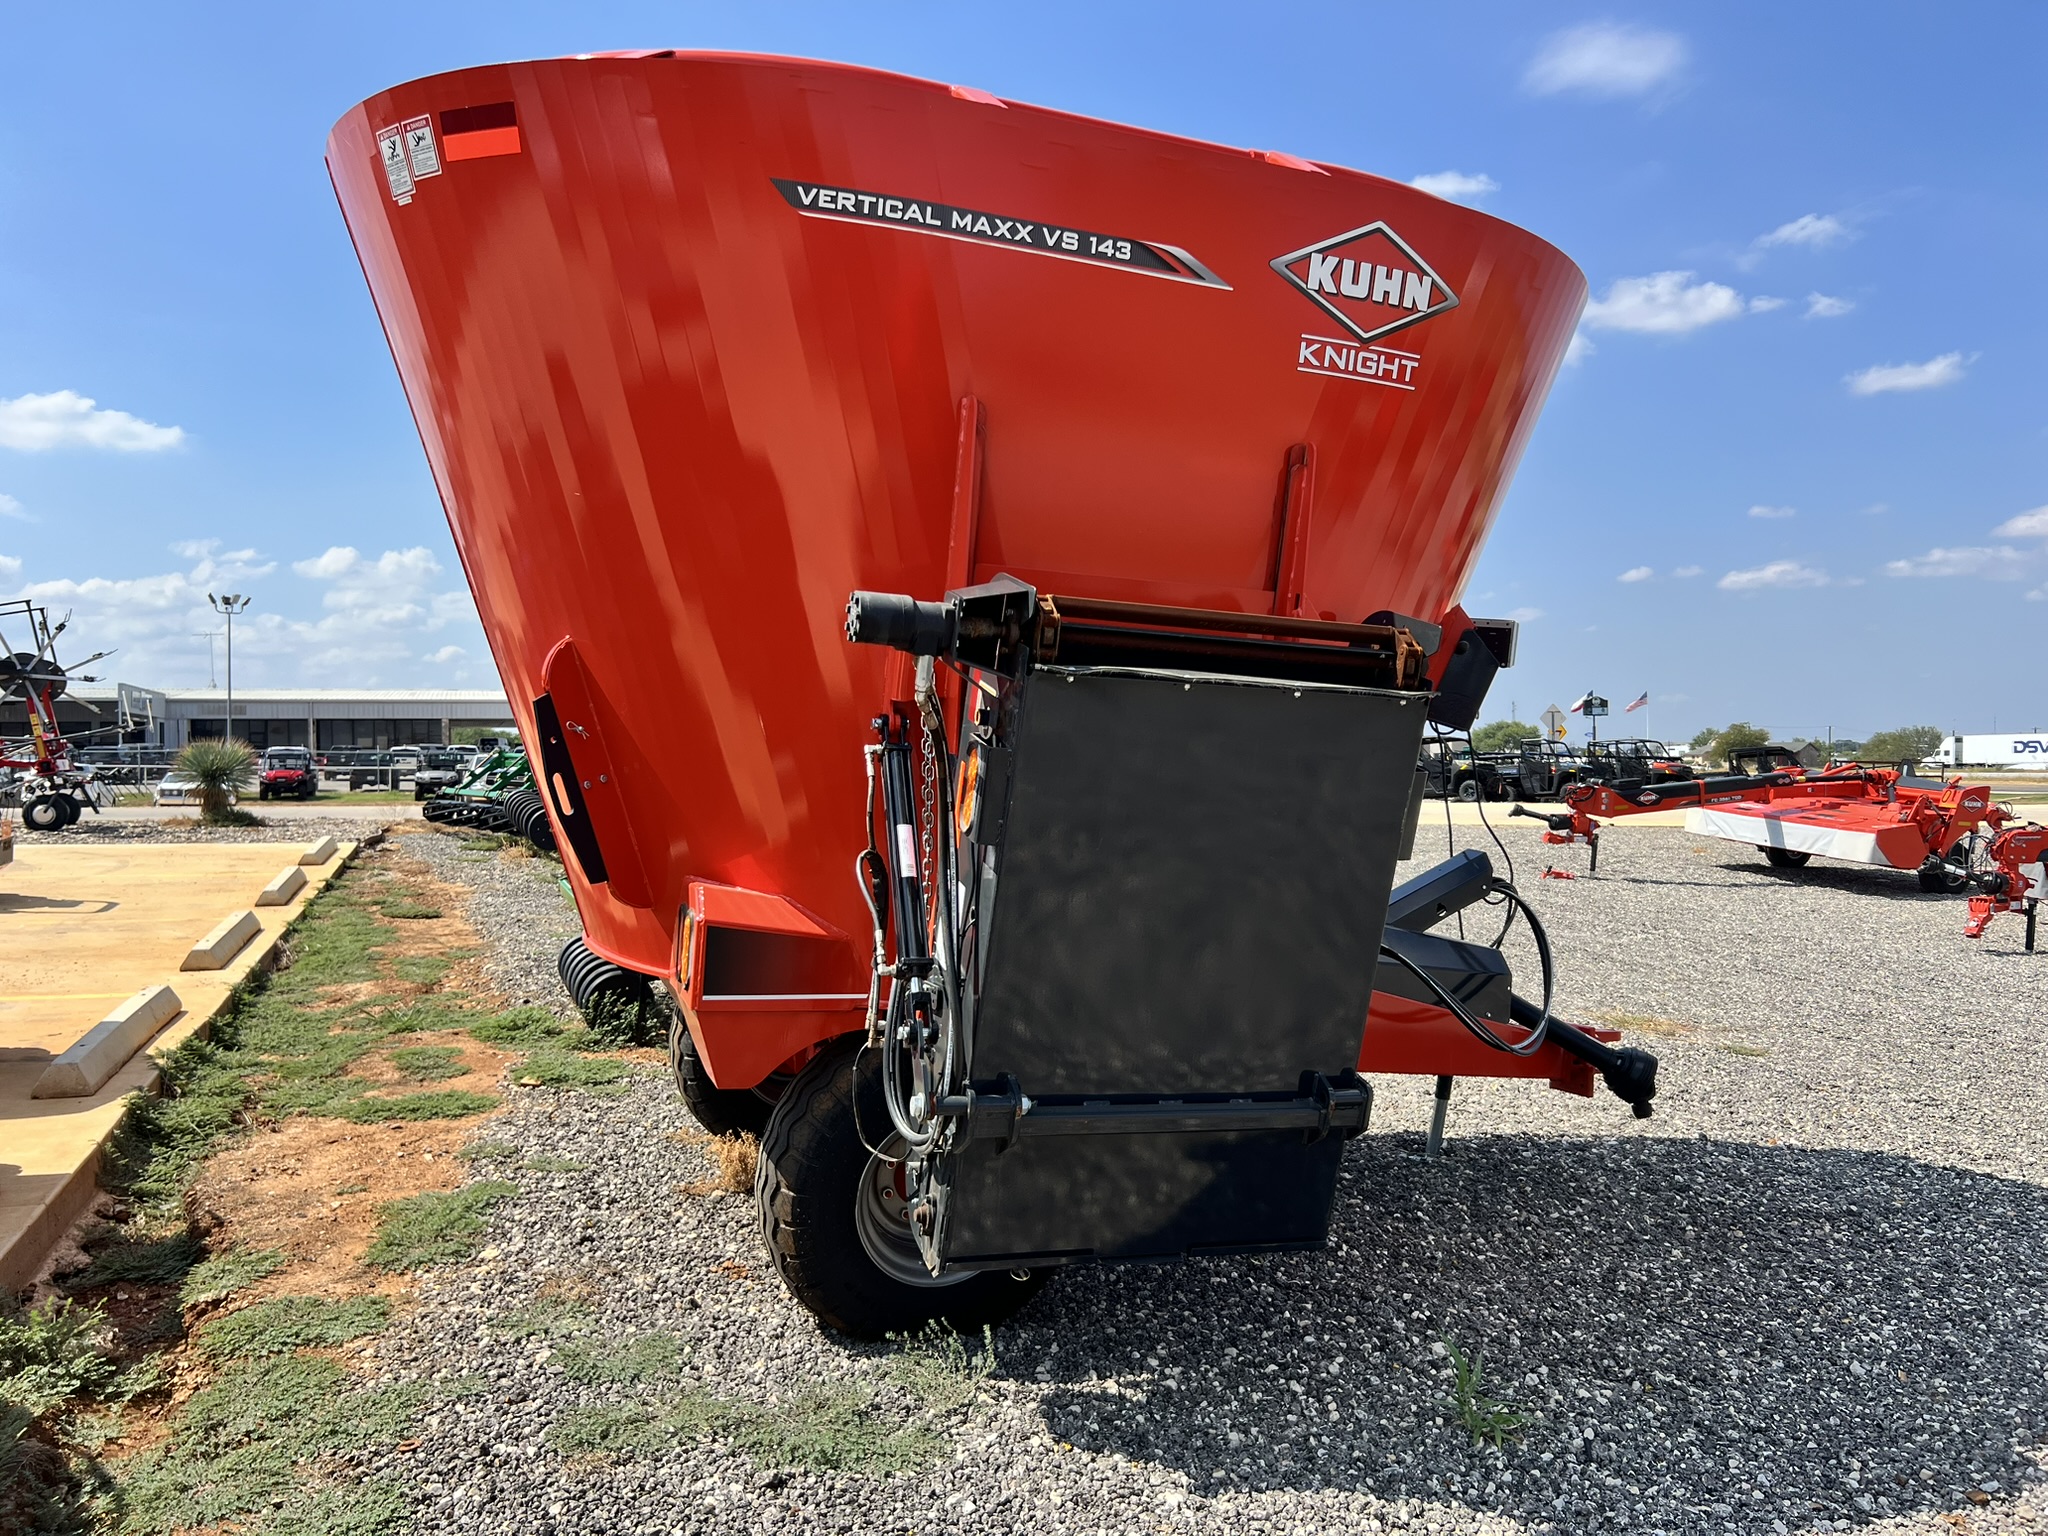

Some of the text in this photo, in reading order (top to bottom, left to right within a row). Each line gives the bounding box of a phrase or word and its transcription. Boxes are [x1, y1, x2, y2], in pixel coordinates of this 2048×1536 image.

[411, 120, 426, 130] DANGER
[797, 185, 1132, 260] VERTICAL MAXX VS 143
[1306, 252, 1433, 313] KUHN
[1298, 341, 1419, 382] KNIGHT
[1964, 800, 1982, 808] KUHN
